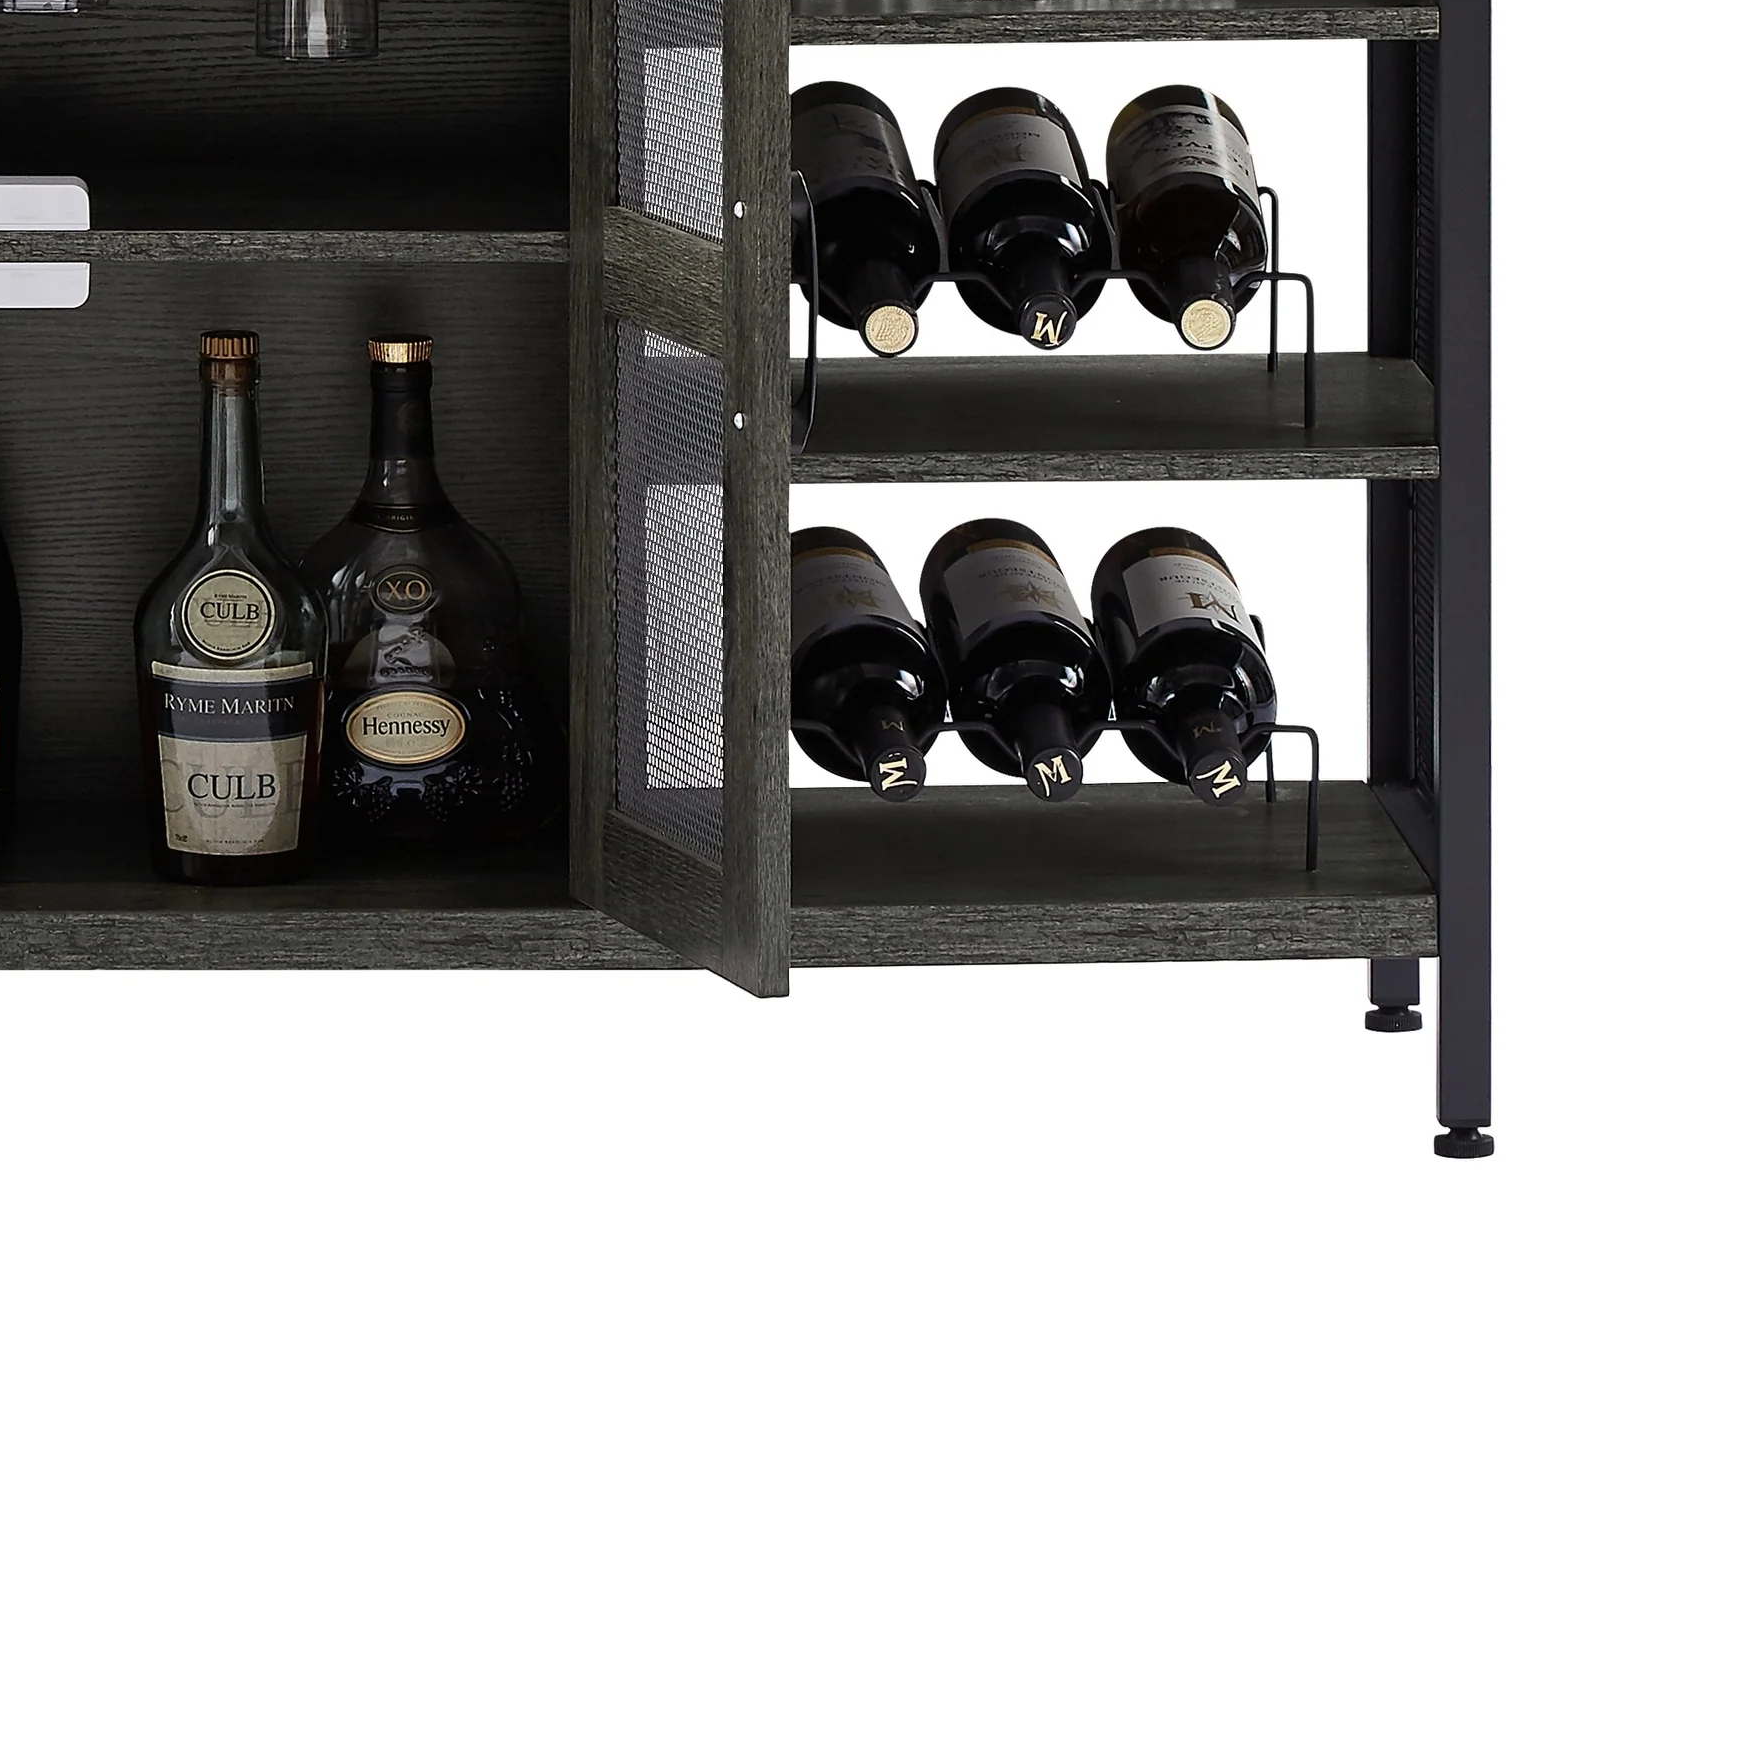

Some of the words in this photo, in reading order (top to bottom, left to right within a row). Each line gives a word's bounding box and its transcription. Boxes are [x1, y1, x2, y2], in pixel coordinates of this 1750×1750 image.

[1030, 310, 1068, 346] M
[385, 579, 426, 601] XO
[200, 601, 260, 620] CULB
[163, 692, 216, 715] RYME
[221, 695, 295, 715] MARITN
[362, 716, 451, 738] Hennessy
[187, 773, 276, 800] CULB
[878, 756, 919, 792] M
[1033, 754, 1073, 798] M
[1195, 760, 1242, 799] M
